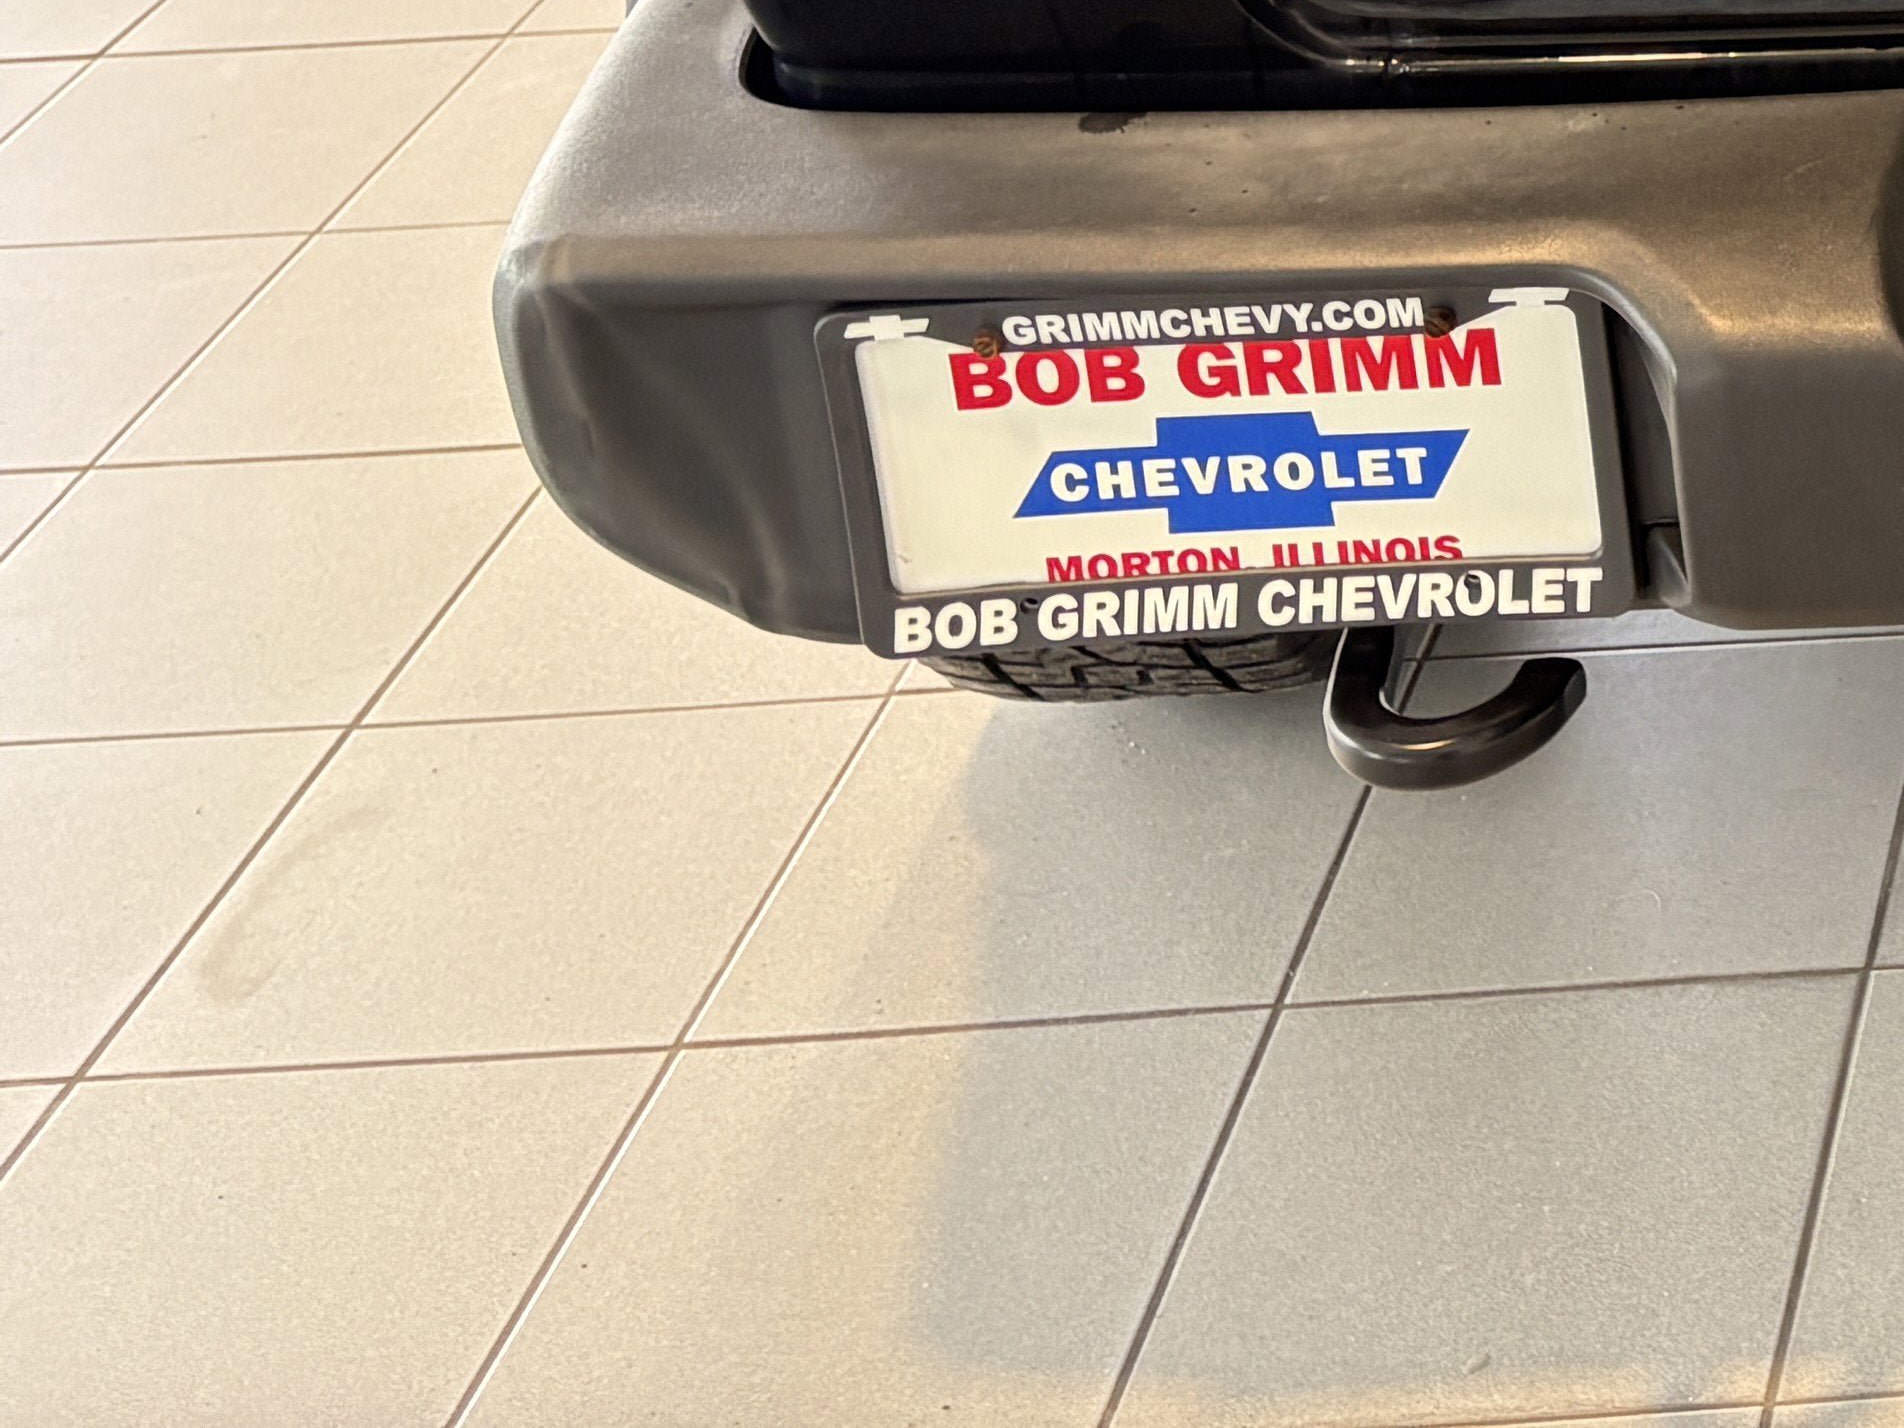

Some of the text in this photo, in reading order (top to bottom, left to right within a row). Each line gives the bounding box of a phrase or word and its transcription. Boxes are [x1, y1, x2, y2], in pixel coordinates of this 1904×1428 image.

[1001, 298, 1424, 346] GRIMMCHEVY.COM
[947, 327, 1503, 411] BOB GRIMM
[1049, 446, 1429, 502] CHEVROLET
[892, 566, 1604, 655] BOB GRIMM CHEVROLET
